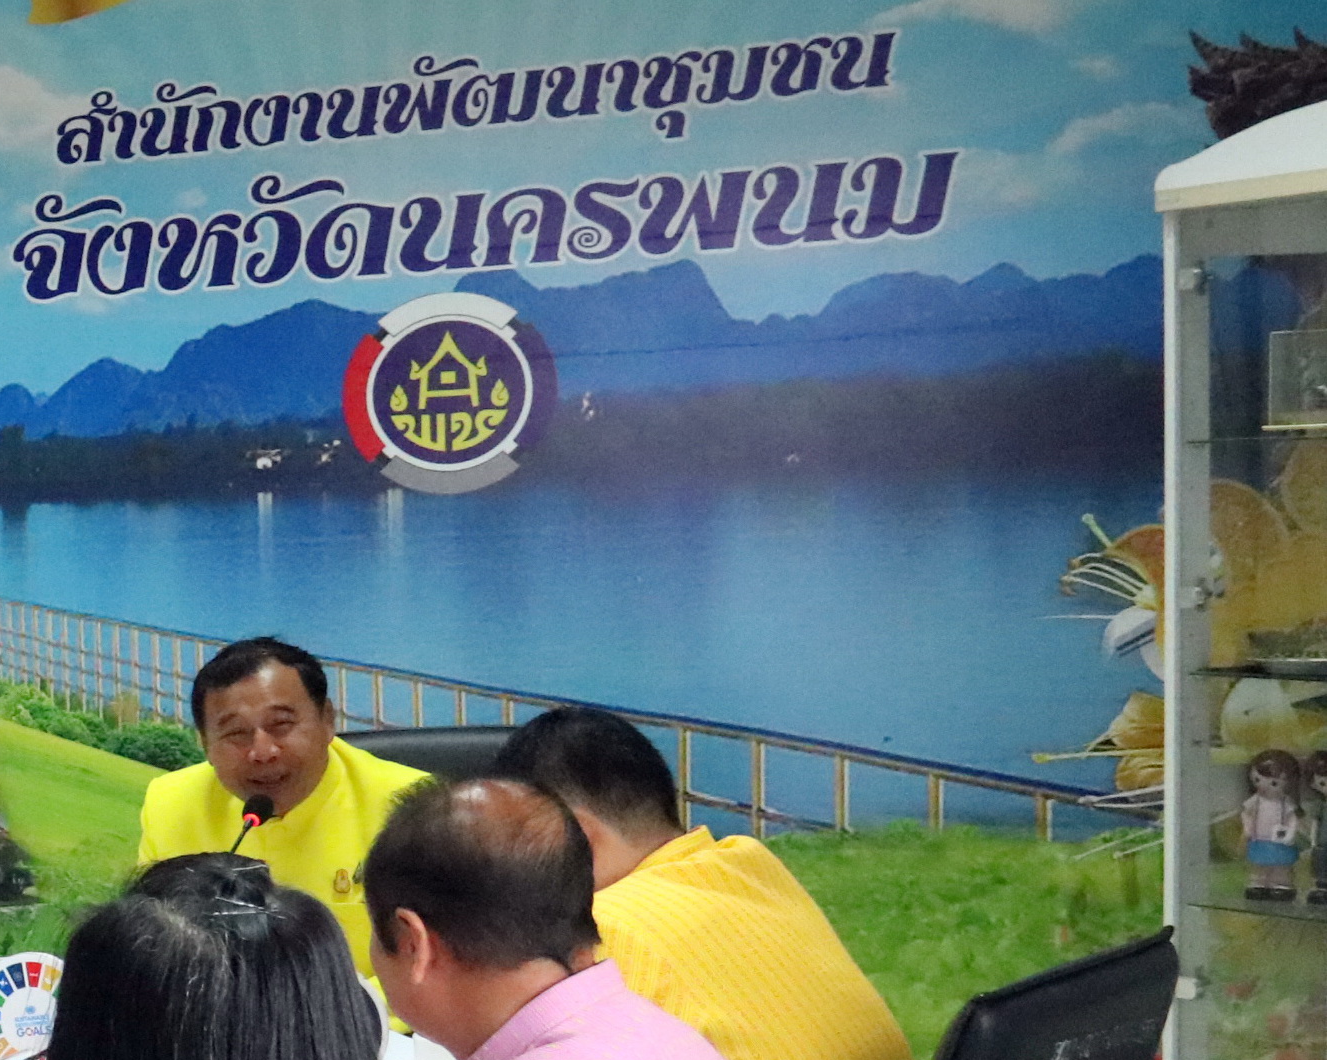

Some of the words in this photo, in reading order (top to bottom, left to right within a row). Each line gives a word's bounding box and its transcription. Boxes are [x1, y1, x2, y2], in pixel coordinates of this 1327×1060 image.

[55, 31, 898, 167] สำนักงานพัฒนาชุมชน
[14, 151, 960, 301] จังหวัดนครพนม
